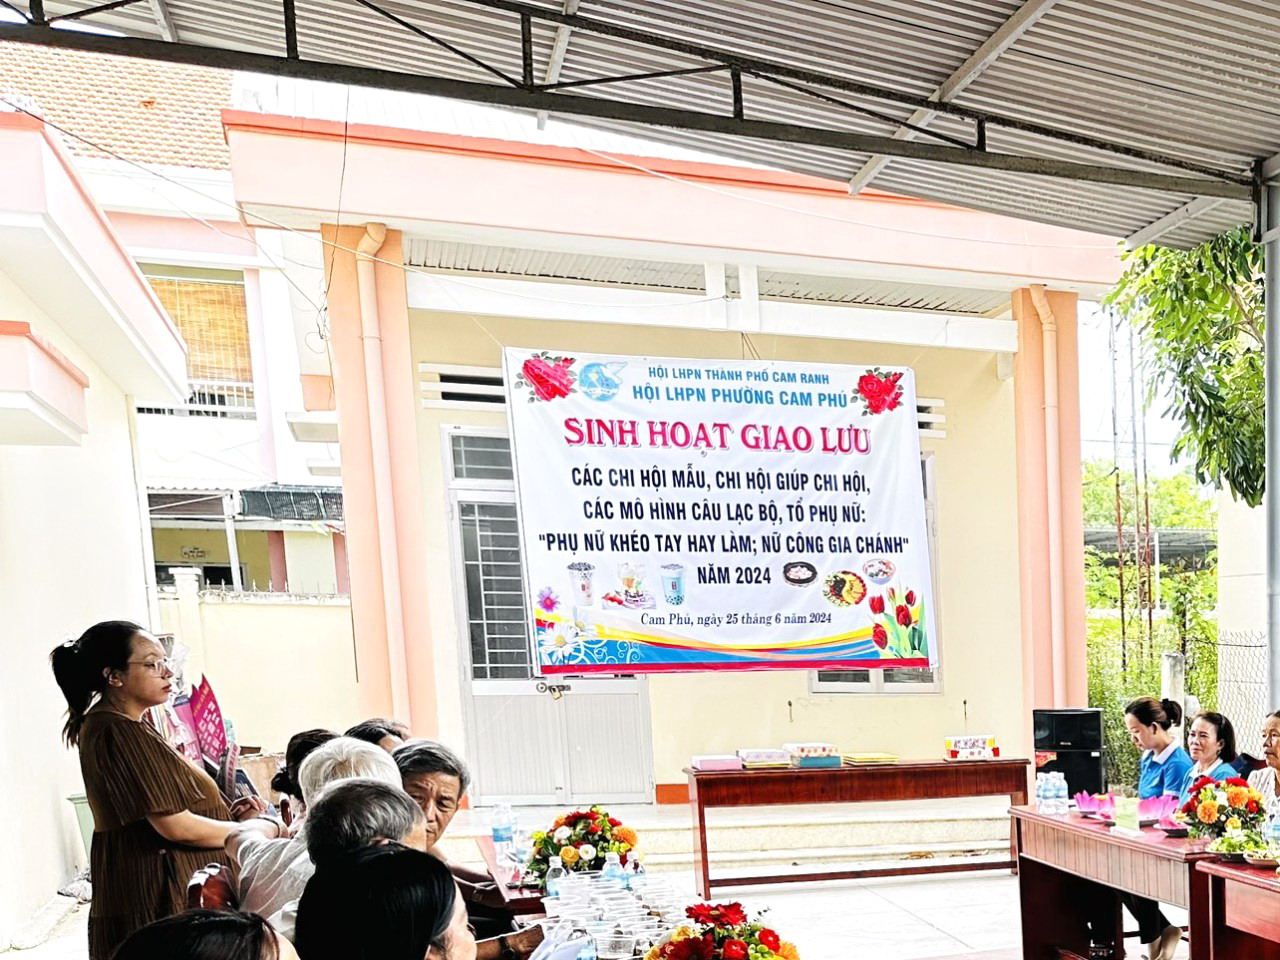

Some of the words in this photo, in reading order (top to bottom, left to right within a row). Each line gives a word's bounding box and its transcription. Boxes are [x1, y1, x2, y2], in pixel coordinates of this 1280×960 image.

[649, 365, 668, 381] HỘI
[672, 368, 702, 380] LHPN
[705, 367, 744, 382] THÀNH
[747, 367, 769, 382] PHỐ
[772, 371, 797, 383] CAM
[800, 373, 830, 385] RANH
[632, 382, 661, 403] HỘI
[666, 386, 706, 402] LHPN
[712, 385, 775, 405] PHƯỜNG
[779, 390, 813, 407] CAM
[818, 389, 848, 408] PHÚ
[564, 417, 641, 447] SINH
[647, 420, 734, 457] HOẠT
[741, 424, 815, 453] GIAO
[820, 423, 871, 455] LƯU
[571, 464, 602, 487] CÁC
[608, 467, 635, 488] CHI
[640, 465, 667, 492] HỘI
[672, 462, 711, 491] MẪU,
[716, 470, 741, 490] CHI
[746, 469, 771, 496] HỘI
[776, 468, 809, 491] GIÚP
[813, 474, 838, 493] CHI
[843, 470, 871, 496] HỘI,
[583, 497, 614, 520] CÁC
[620, 498, 645, 520] MÔ
[649, 498, 686, 521] HÌNH
[691, 499, 722, 522] CÂU
[727, 502, 754, 525] LẠC
[759, 499, 783, 525] BỘ,
[786, 497, 805, 522] TỔ
[809, 504, 838, 527] PHỤ
[842, 501, 867, 524] NỮ:
[539, 532, 579, 556] "PHỤ
[584, 529, 605, 552] NỮ
[610, 530, 650, 553] KHÉO
[654, 534, 682, 553] TAY
[687, 534, 716, 553] HAY
[721, 530, 757, 556] LÀM;
[761, 531, 781, 553] NỮ
[786, 531, 824, 554] CÔNG
[828, 536, 852, 554] GIA
[856, 532, 909, 554] CHÁNH"
[697, 563, 730, 585] NĂM
[735, 566, 771, 585] 2024
[641, 612, 666, 626] Cam
[668, 612, 694, 628] Phú,
[696, 612, 723, 629] ngày
[726, 612, 738, 625] 25
[741, 612, 772, 626] tháng
[774, 612, 781, 624] 6
[784, 613, 807, 625] năm
[809, 612, 832, 624] 2024
